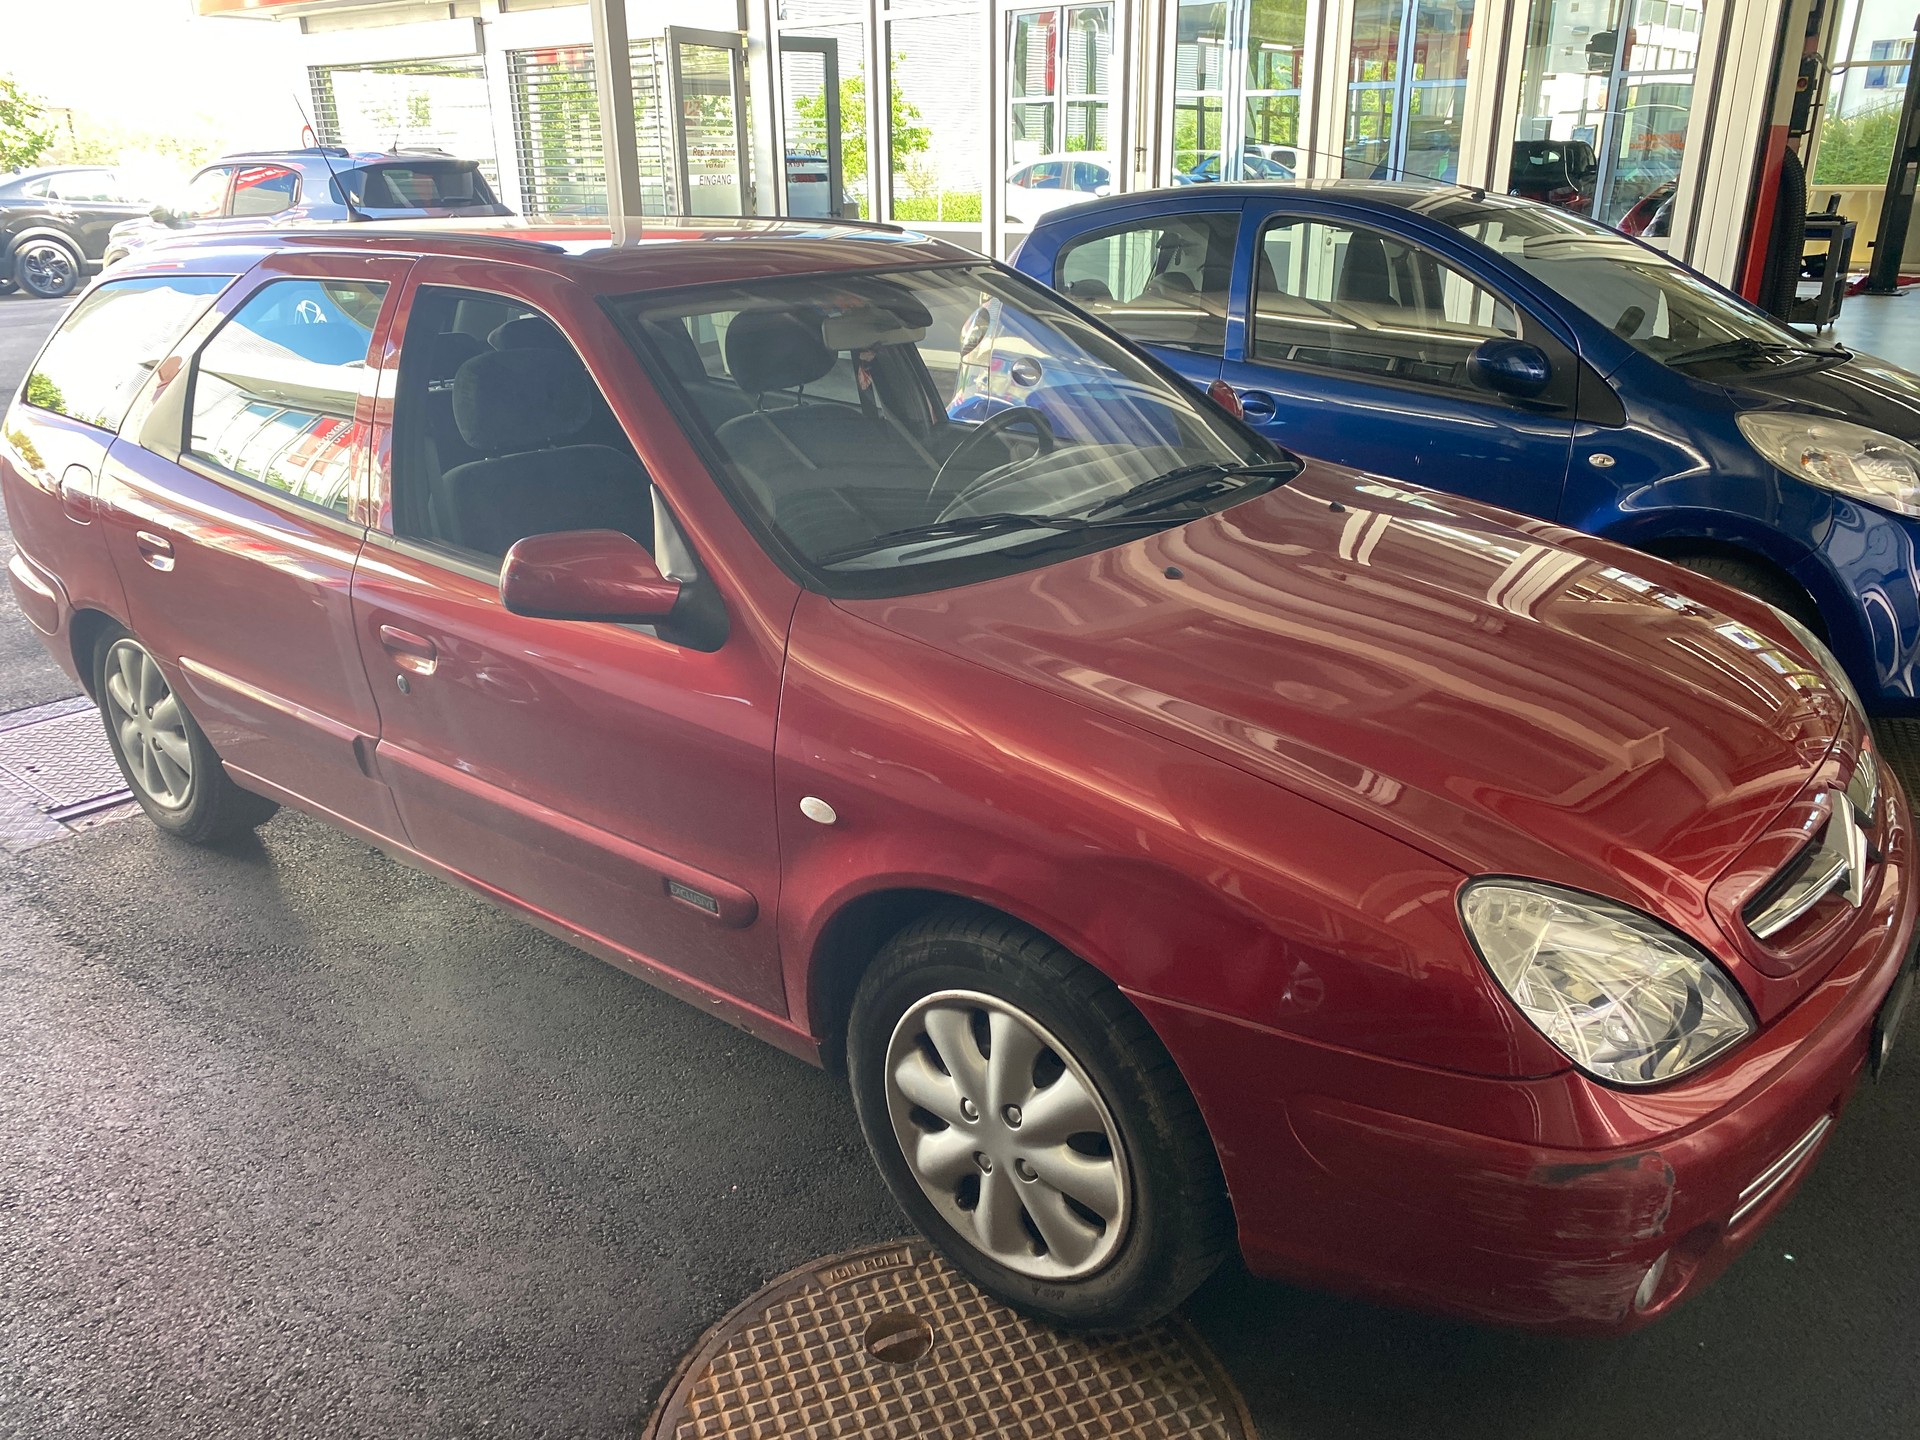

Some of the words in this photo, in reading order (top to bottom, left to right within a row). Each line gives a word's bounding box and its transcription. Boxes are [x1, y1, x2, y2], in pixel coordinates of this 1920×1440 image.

[699, 174, 732, 186] EINGANG
[670, 884, 716, 911] EXCLUSIVE
[829, 1263, 858, 1280] VON
[861, 1252, 902, 1272] ROLL
